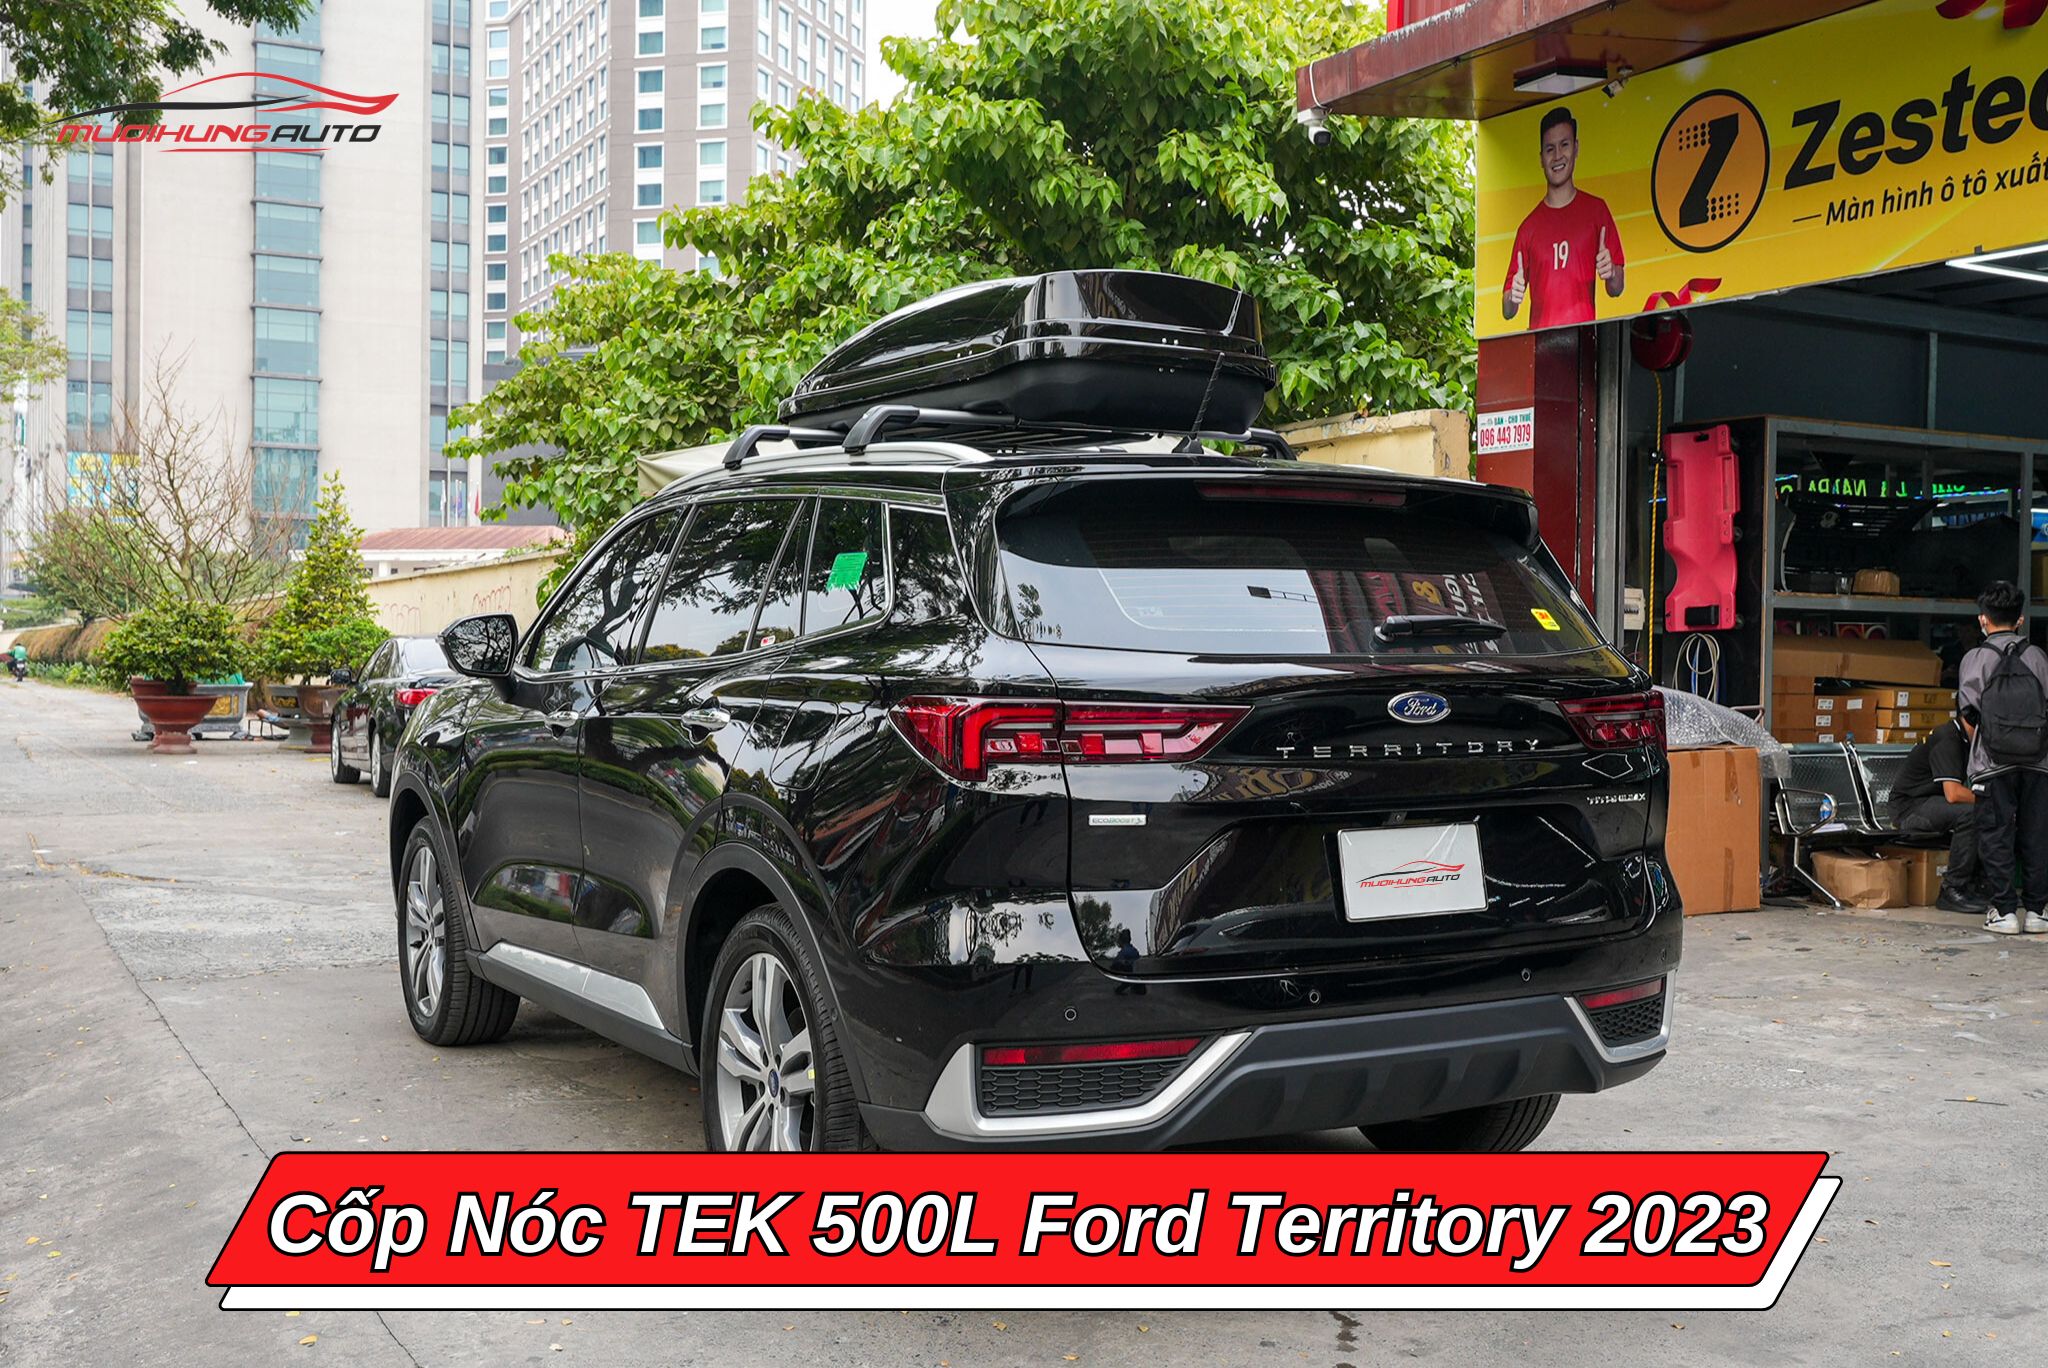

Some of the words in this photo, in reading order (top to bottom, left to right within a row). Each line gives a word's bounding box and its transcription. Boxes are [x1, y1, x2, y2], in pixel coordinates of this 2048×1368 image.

[1825, 196, 1874, 226] Màn
[1881, 181, 1933, 214] hình
[1940, 176, 1955, 202] ô
[1962, 169, 1988, 198] tô
[1553, 240, 1569, 270] 19
[1480, 427, 1495, 447] 096
[1497, 425, 1511, 445] 443
[1513, 423, 1531, 443] 7979
[1403, 697, 1437, 716] Ford
[1276, 739, 1539, 759] TERRITORY
